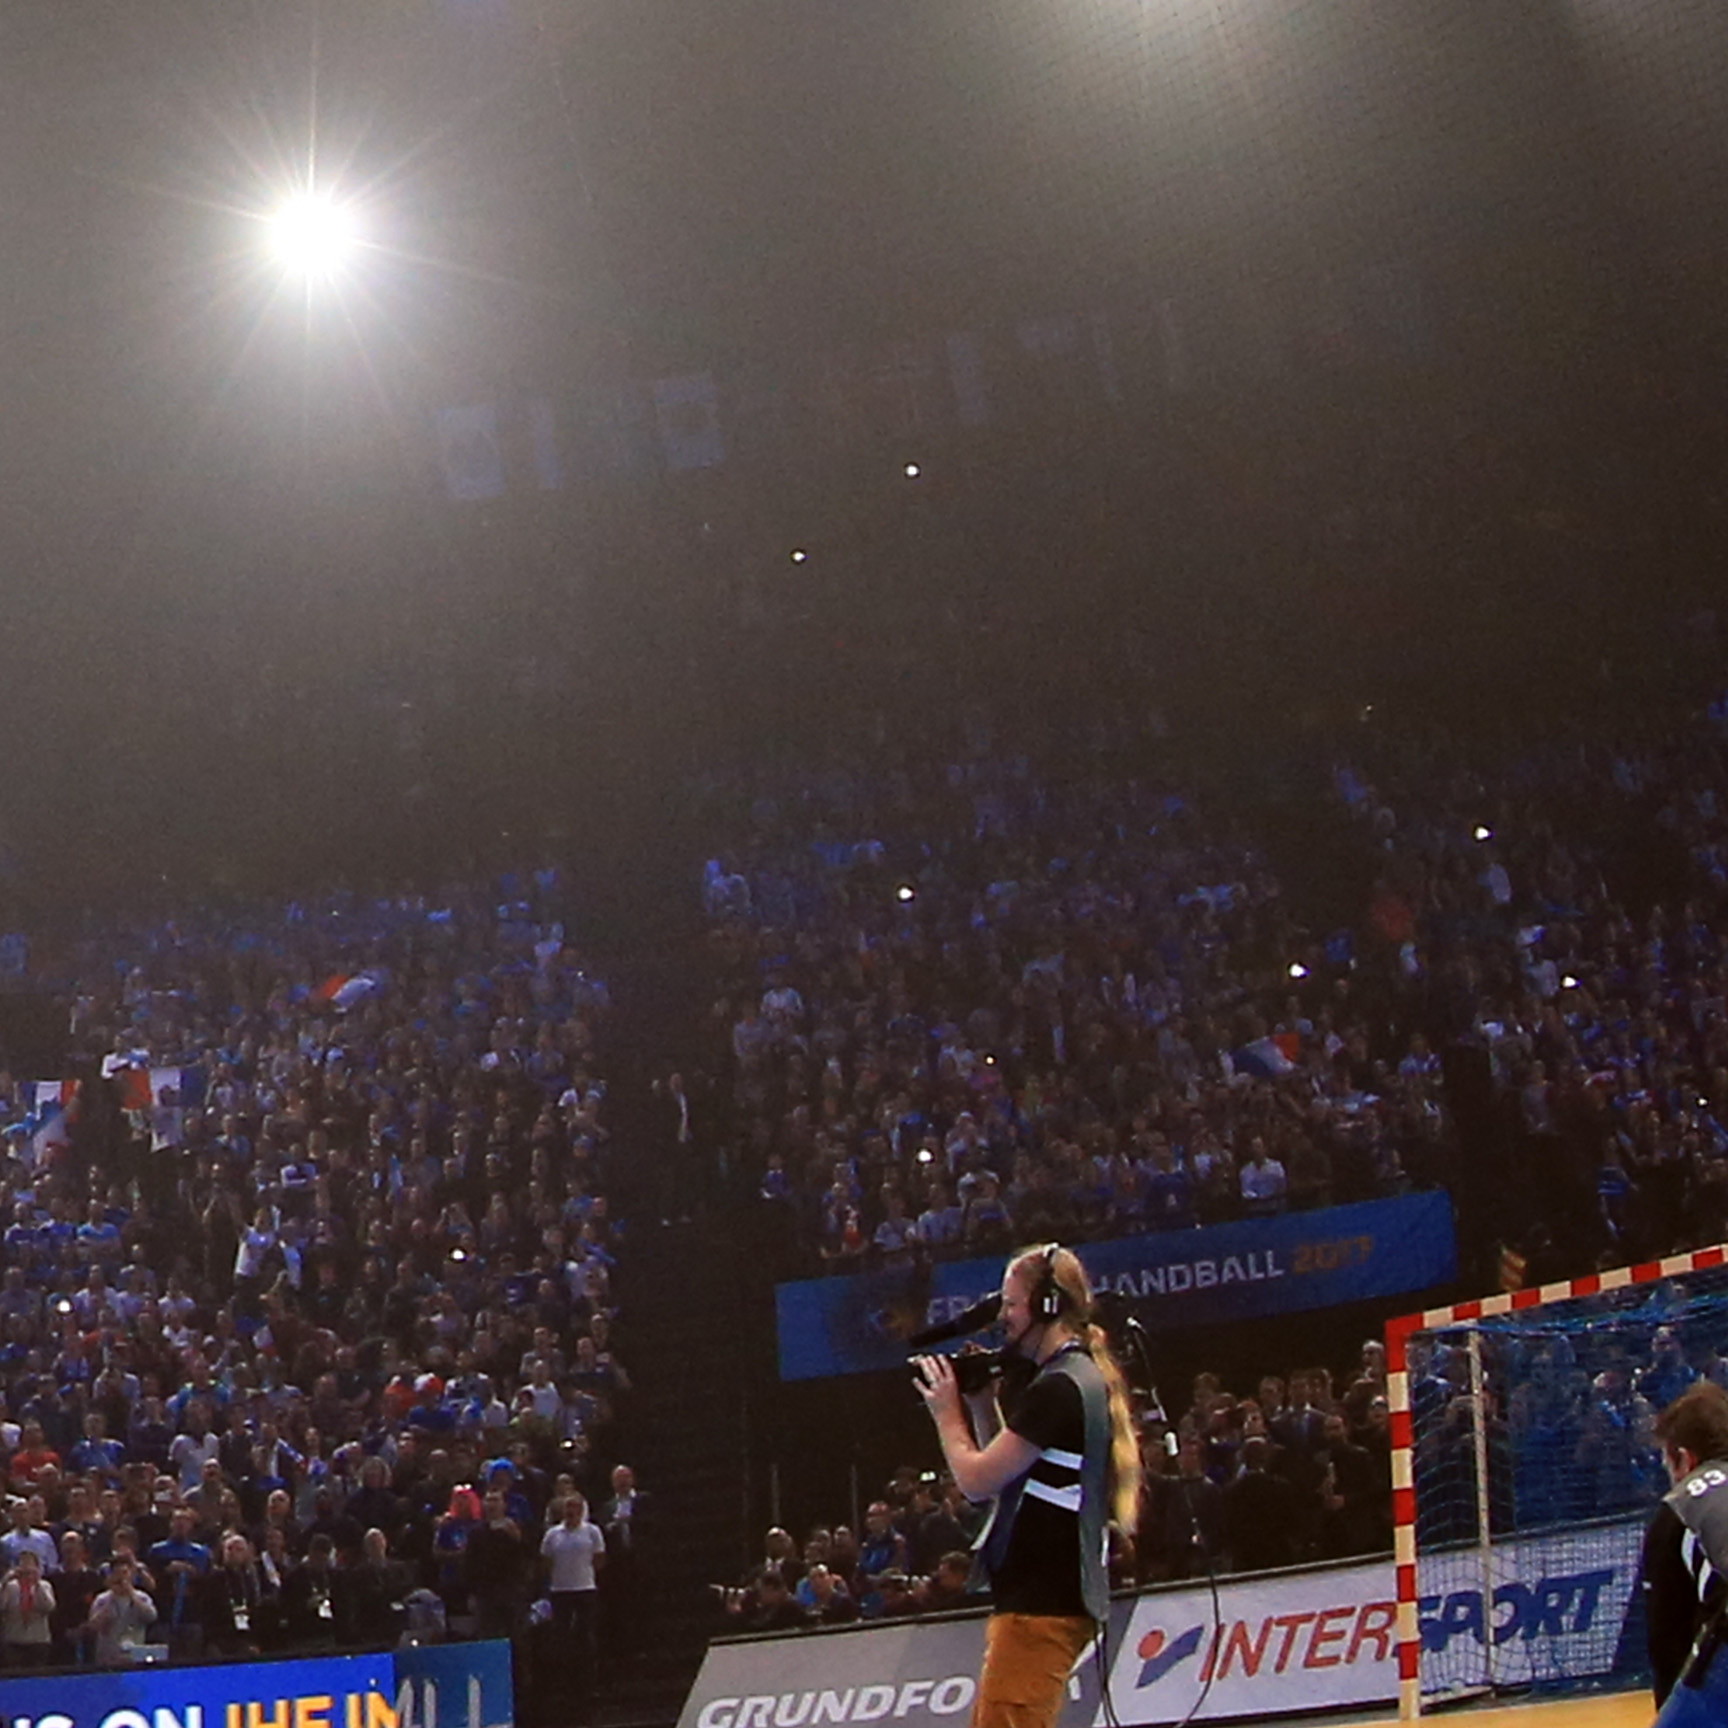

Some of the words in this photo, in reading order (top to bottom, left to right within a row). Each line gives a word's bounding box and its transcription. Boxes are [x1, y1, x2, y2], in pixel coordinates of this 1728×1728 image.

[1293, 1236, 1373, 1275] 2017
[1685, 1468, 1728, 1497] 83
[1199, 1569, 1613, 1682] INTERSPORT
